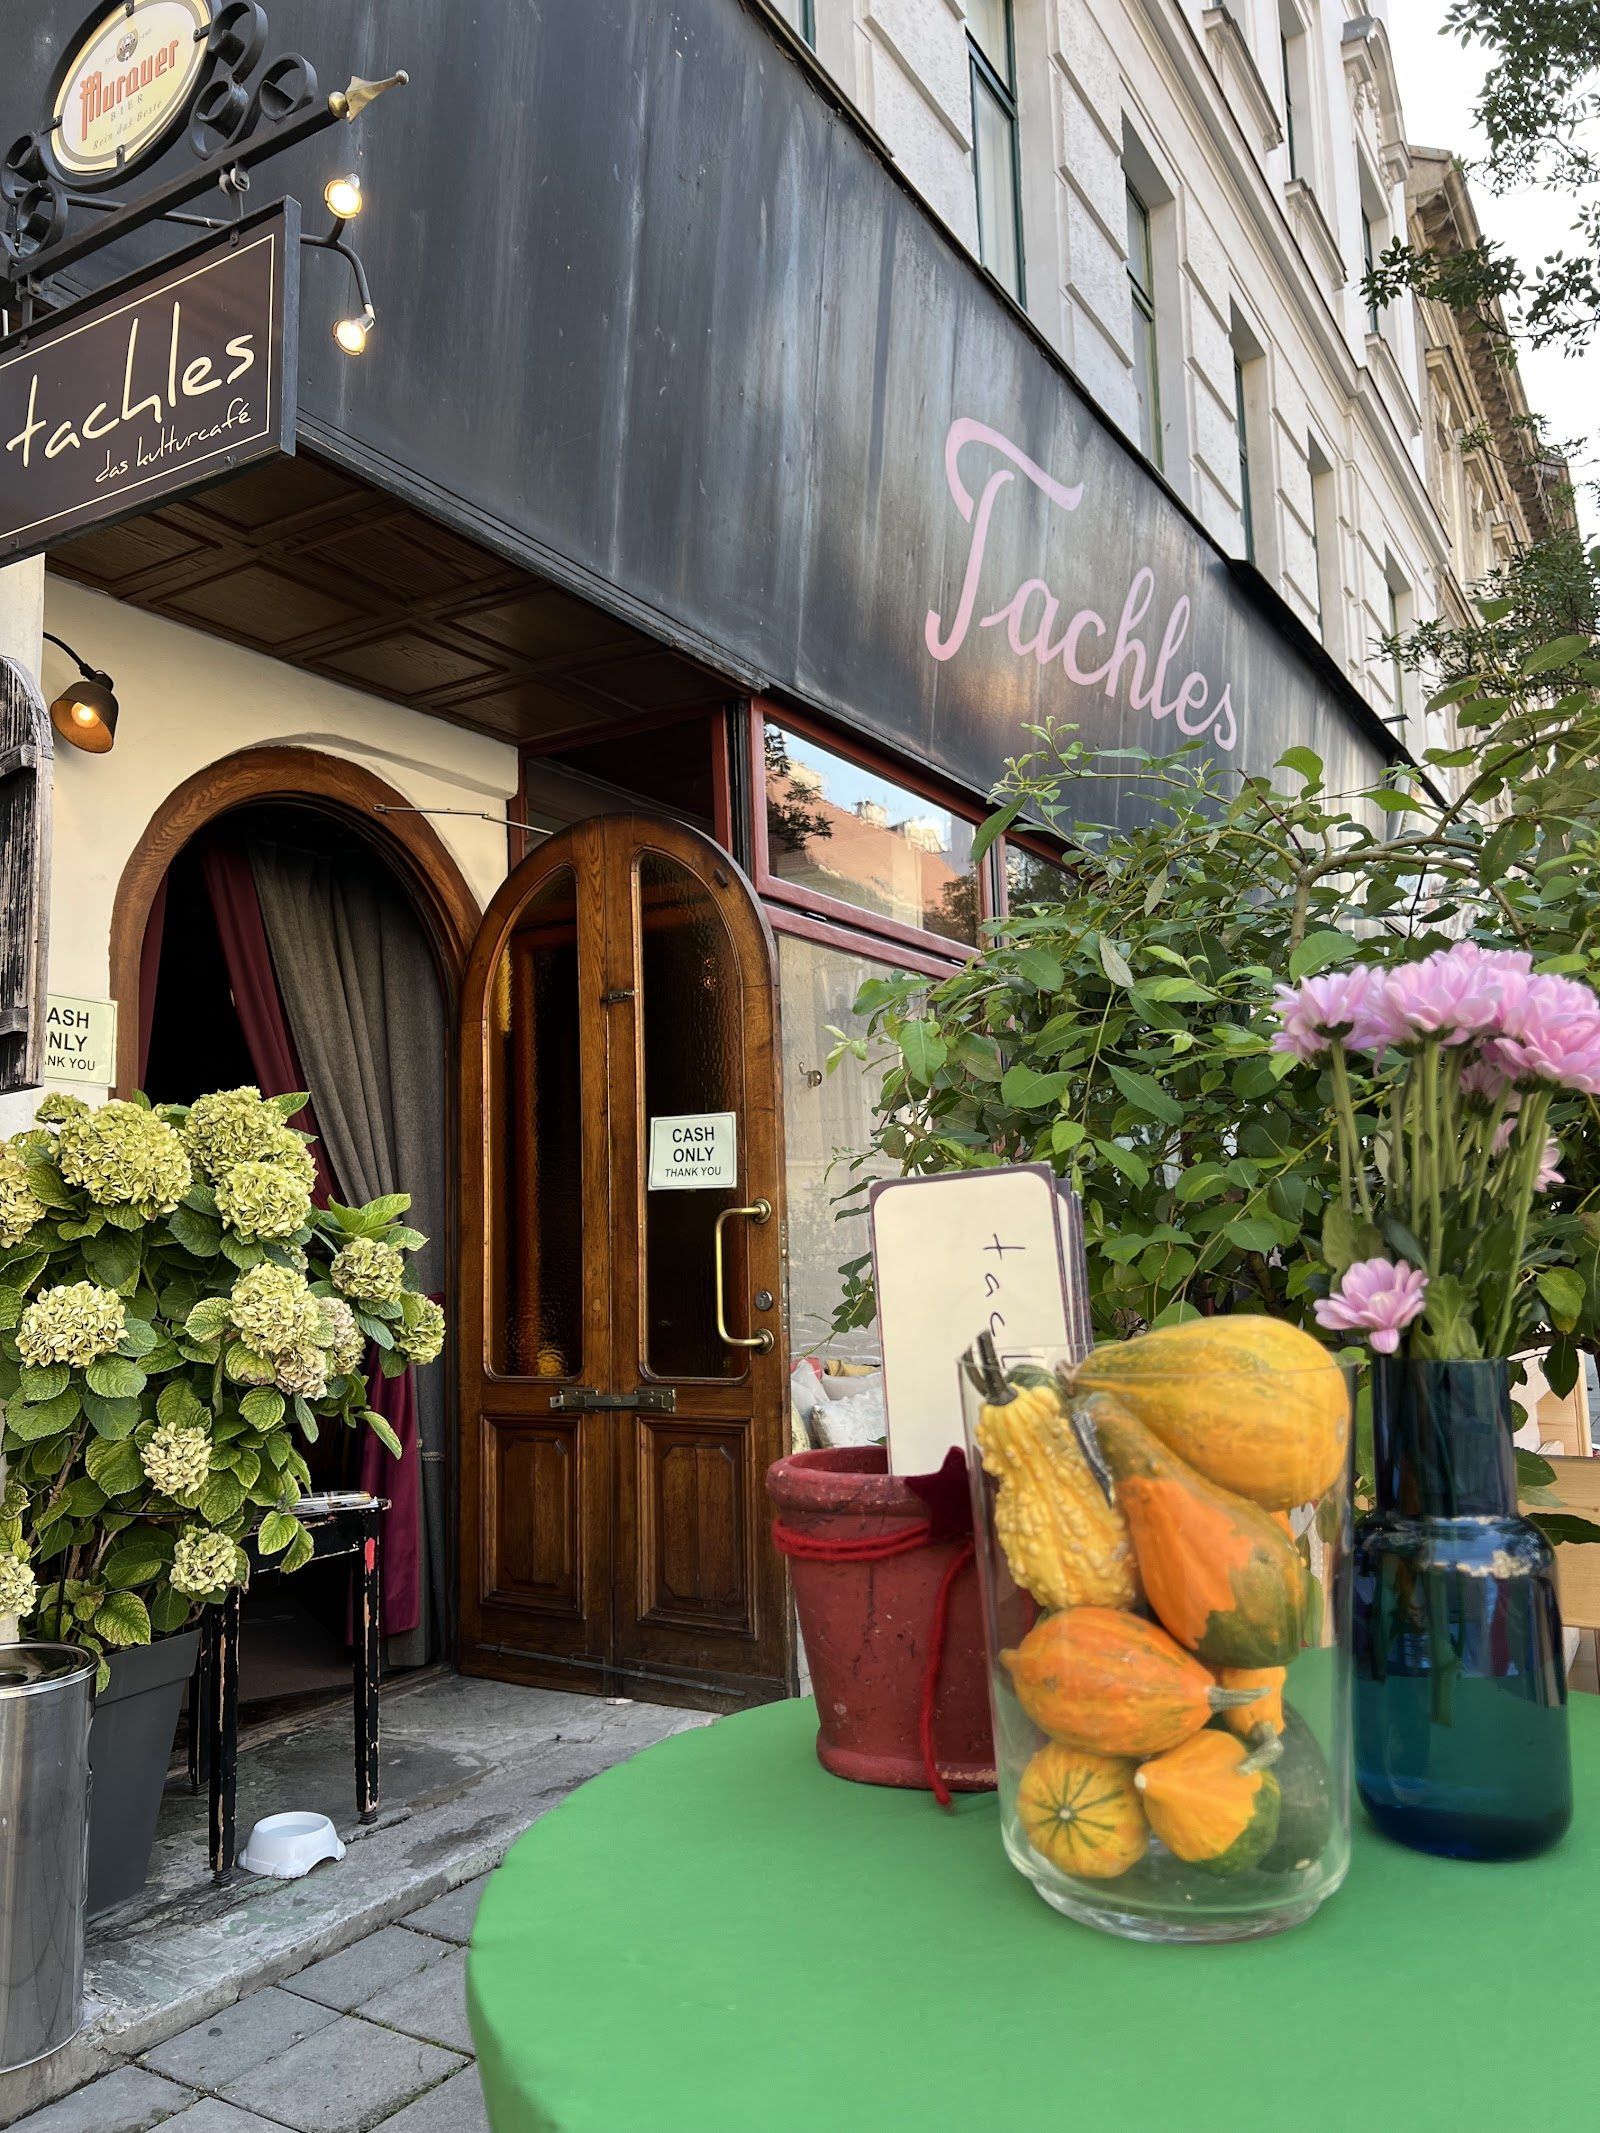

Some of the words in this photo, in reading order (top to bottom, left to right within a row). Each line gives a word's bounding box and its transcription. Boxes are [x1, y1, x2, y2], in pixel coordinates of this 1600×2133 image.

[79, 39, 179, 141] Murauer
[110, 94, 143, 121] BIER
[93, 133, 113, 150] Rein
[137, 101, 162, 121] Beste
[6, 301, 255, 468] tachles
[95, 450, 129, 483] das
[136, 397, 252, 467] kulturcafé
[925, 417, 1237, 751] Tachles
[46, 1007, 89, 1029] ASH
[45, 1031, 88, 1052] NLY
[69, 1058, 95, 1071] YOU
[672, 1126, 715, 1143] CASH
[673, 1147, 715, 1163] ONLY
[665, 1167, 698, 1177] THANK
[701, 1166, 721, 1176] YOU
